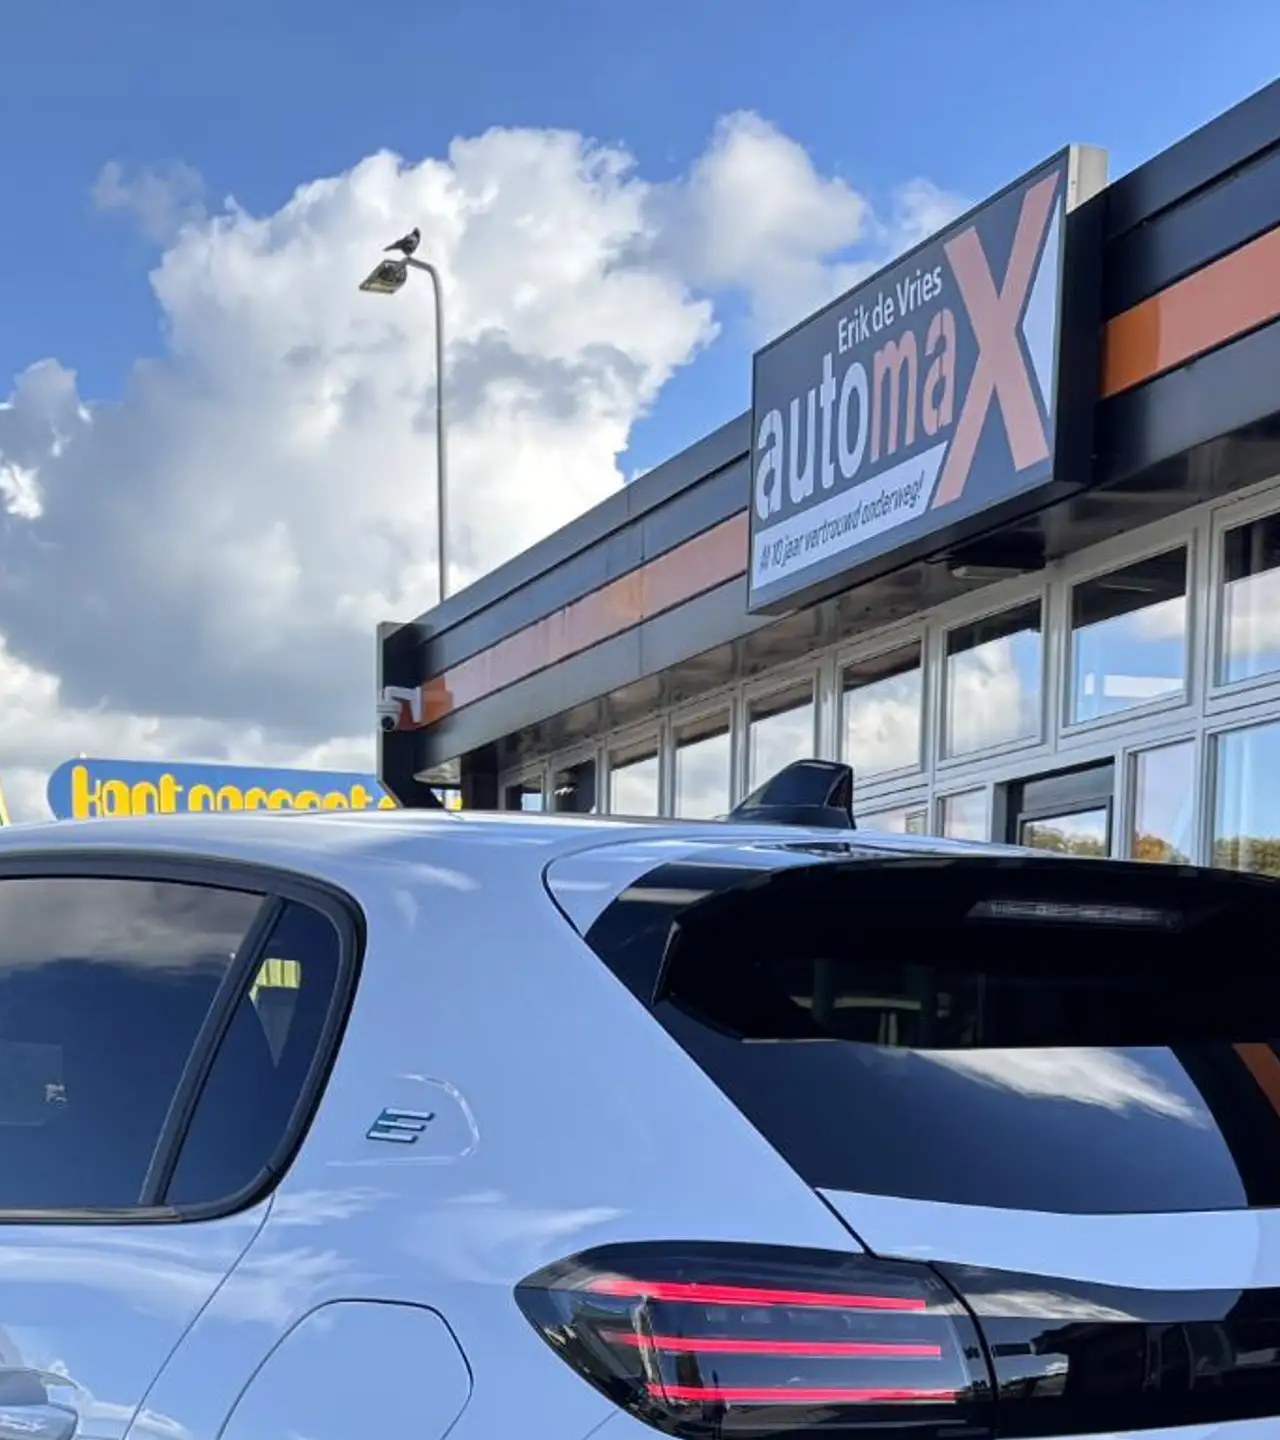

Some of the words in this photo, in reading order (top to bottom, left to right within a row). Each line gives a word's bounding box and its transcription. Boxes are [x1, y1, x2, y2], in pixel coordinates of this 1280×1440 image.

[838, 305, 870, 354] Erik
[871, 293, 894, 333] de
[896, 266, 943, 317] Vries
